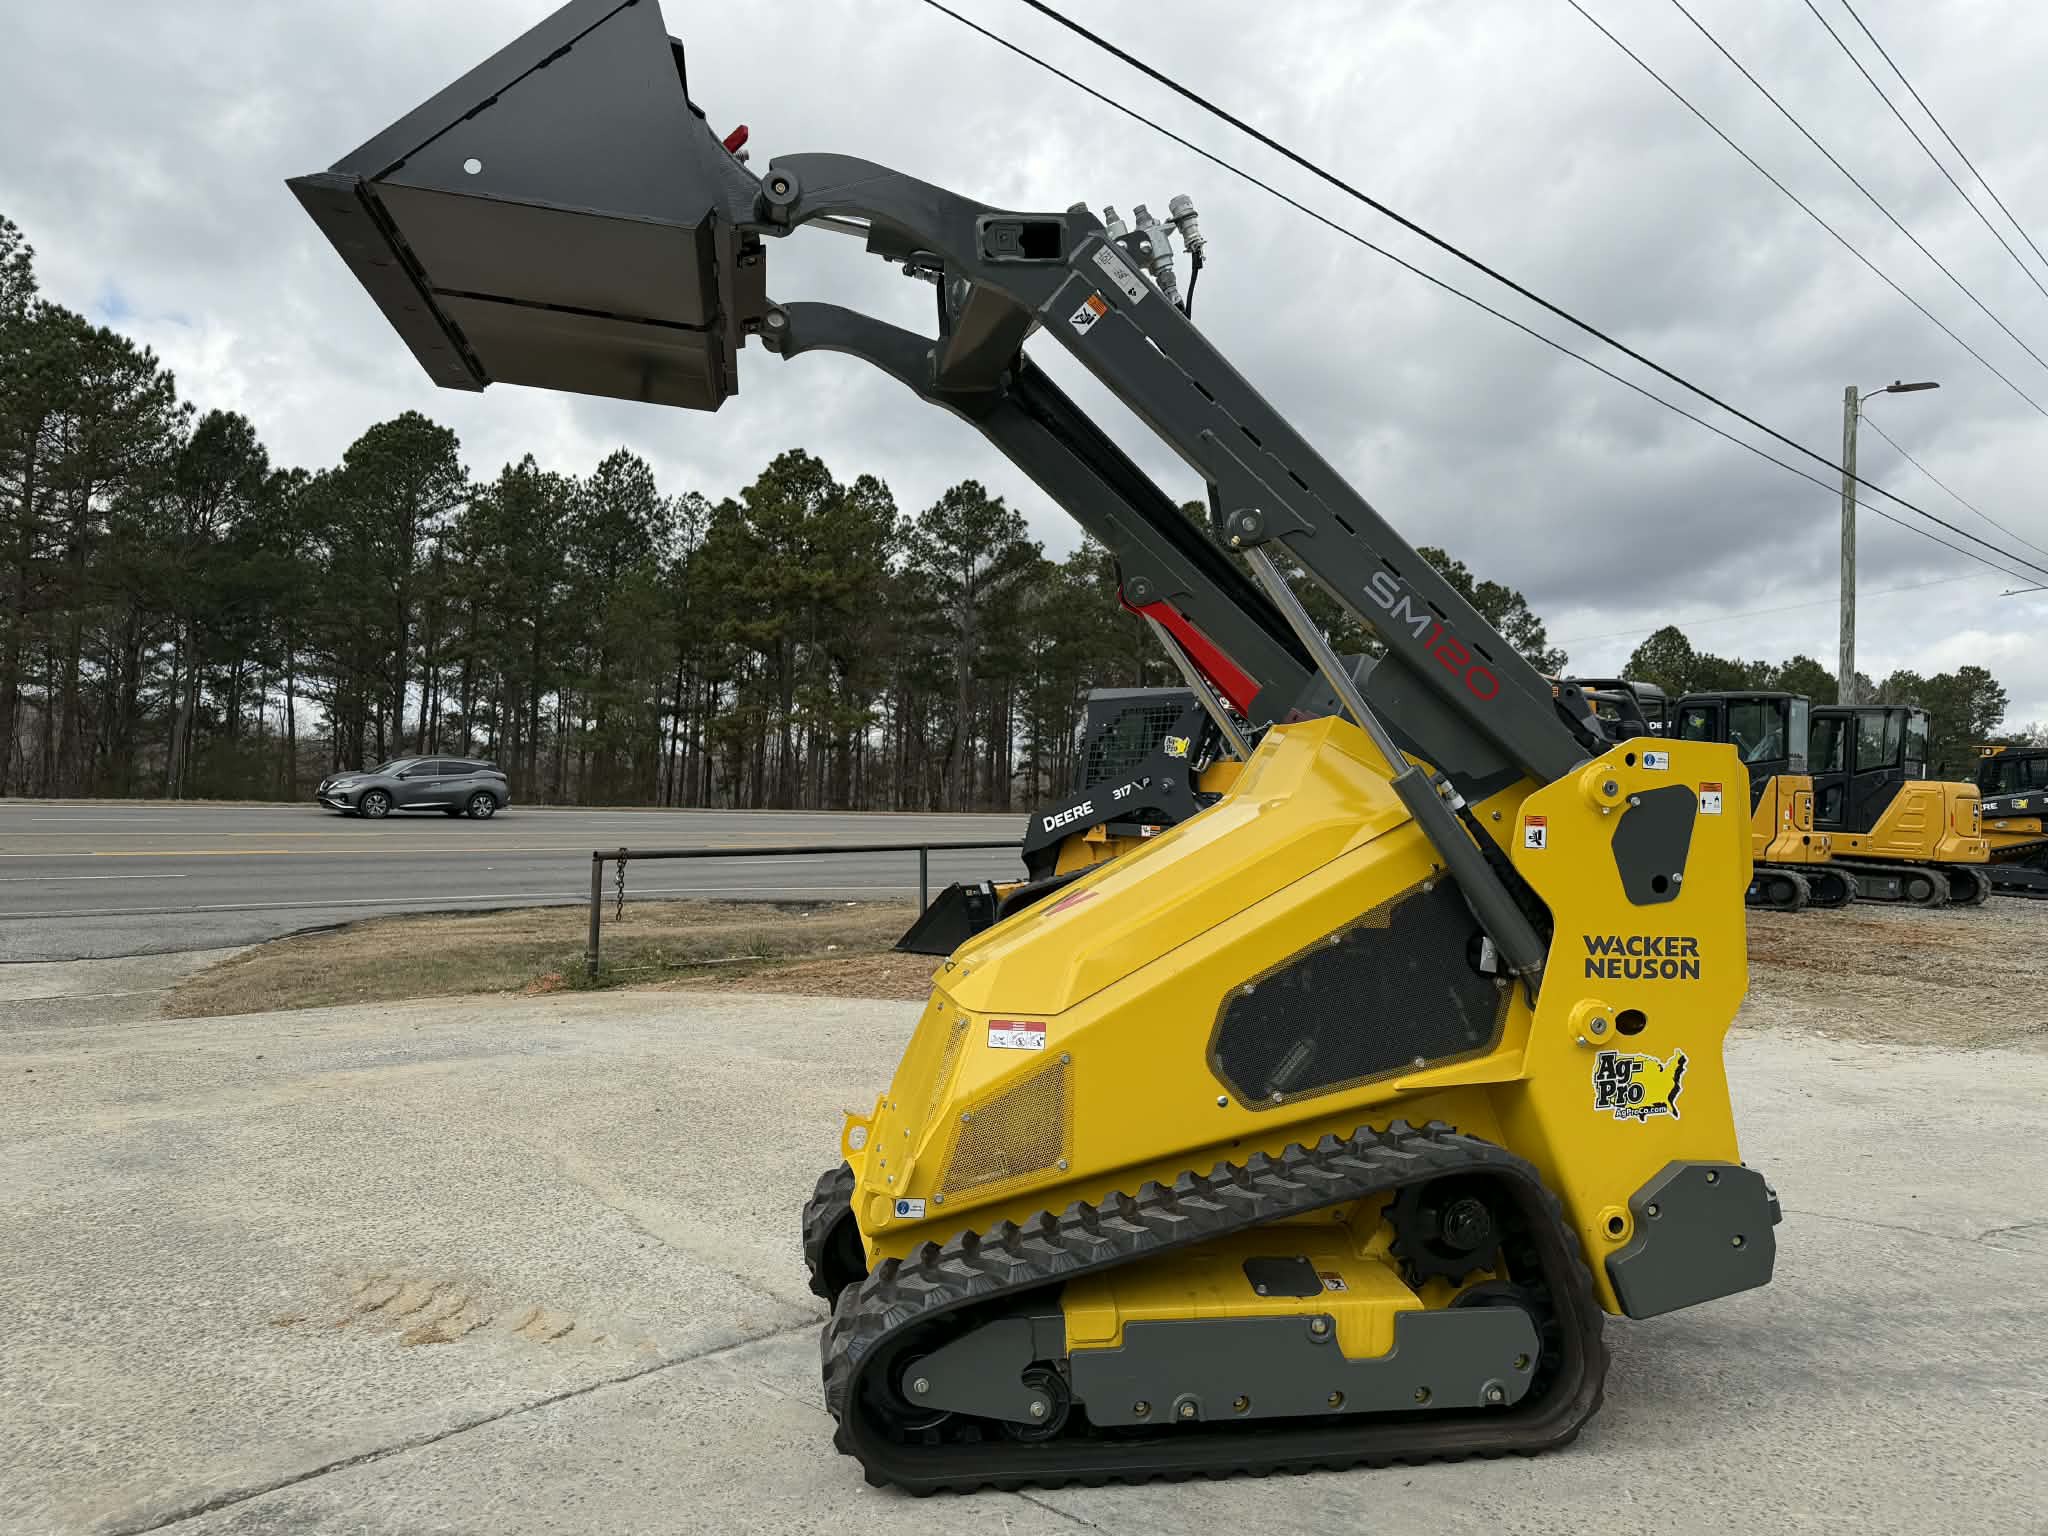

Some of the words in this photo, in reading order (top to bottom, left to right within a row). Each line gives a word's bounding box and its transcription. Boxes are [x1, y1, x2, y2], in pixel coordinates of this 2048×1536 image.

[1043, 801, 1094, 832] DEERE
[1583, 935, 1699, 957] WACKER
[1585, 958, 1699, 979] NEUSON
[1596, 1080, 1645, 1107] Pro
